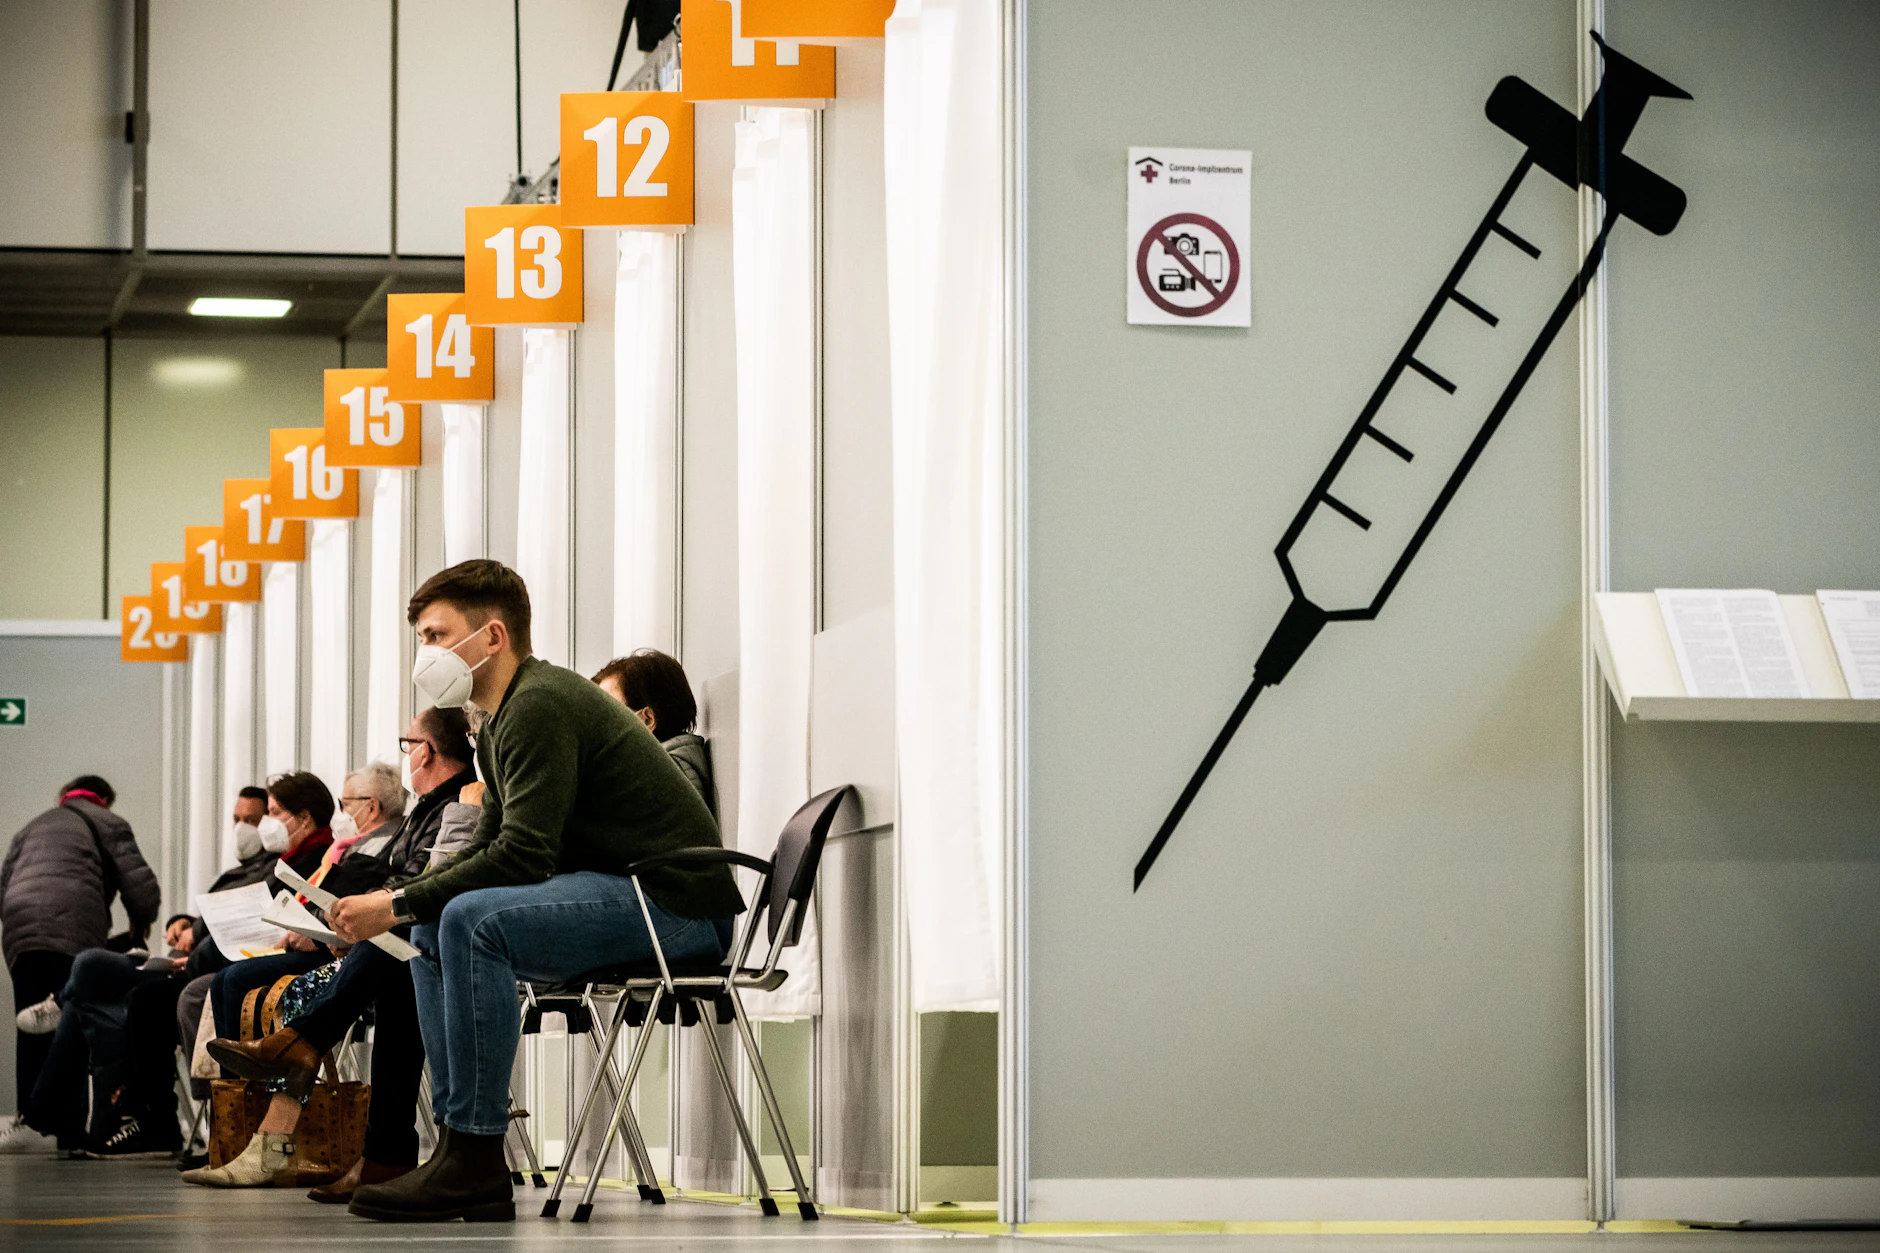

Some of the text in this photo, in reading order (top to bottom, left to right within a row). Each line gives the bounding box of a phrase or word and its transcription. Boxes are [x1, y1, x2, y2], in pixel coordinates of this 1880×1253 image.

[583, 115, 670, 198] 12
[484, 225, 562, 299] 13
[405, 314, 475, 378] 14
[340, 386, 404, 446] 15
[284, 445, 344, 500] 16
